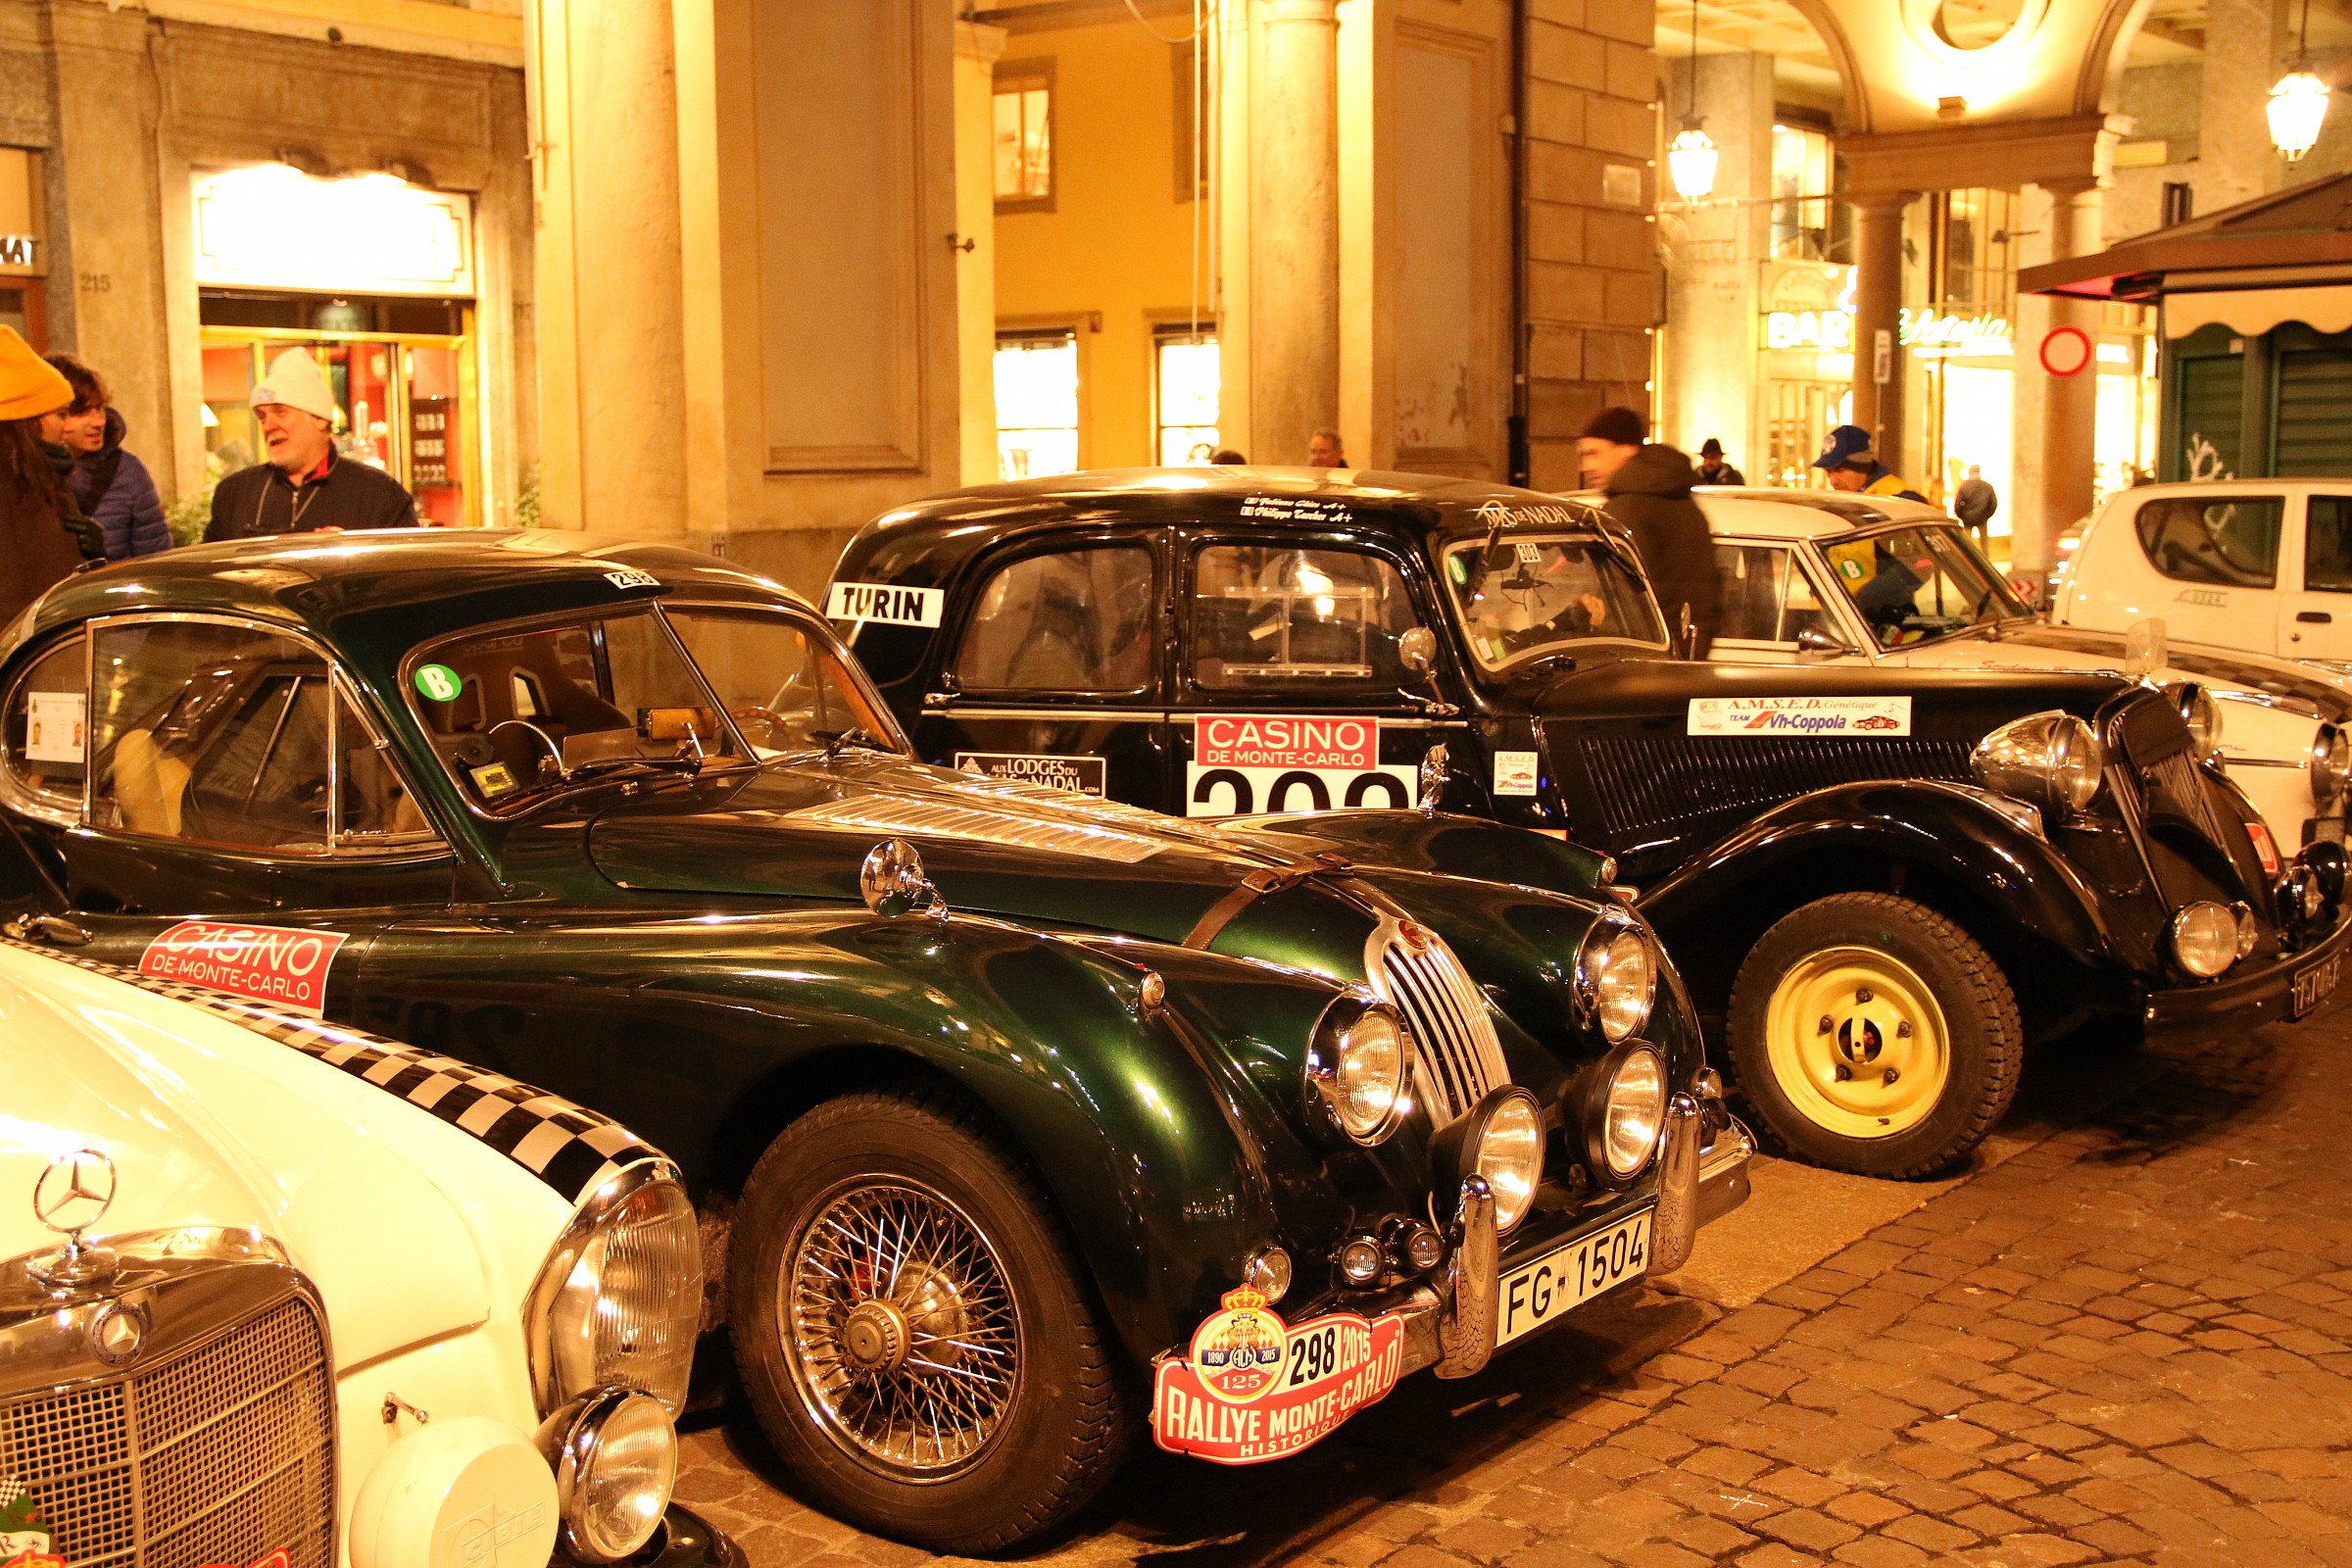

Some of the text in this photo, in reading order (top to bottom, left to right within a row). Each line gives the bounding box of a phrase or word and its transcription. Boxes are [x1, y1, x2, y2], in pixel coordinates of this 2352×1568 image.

[1767, 311, 1850, 348] BAR
[1522, 506, 1575, 524] NADAL
[1519, 543, 1540, 562] 303
[611, 572, 656, 586] 298
[1448, 555, 1465, 583] B
[1842, 560, 1861, 578] B
[843, 587, 924, 621] TURIN
[419, 666, 454, 701] B
[1207, 719, 1365, 751] CASINO
[1770, 714, 1846, 733] Vh-Coppola
[1007, 759, 1065, 776] LODGES
[1065, 767, 1078, 776] DU
[1206, 750, 1365, 767] DE MONTE-CARLO
[166, 925, 322, 977] CASINO
[151, 954, 312, 1002] DE MONTE-CARLO
[1207, 1351, 1225, 1365] 1890
[1261, 1348, 1276, 1362] 2015
[1289, 1326, 1337, 1387] 298
[1342, 1325, 1372, 1372] 2015
[1167, 1385, 1261, 1445] RALLYE
[1268, 1339, 1400, 1440] MONTE-CARLO
[1221, 1373, 1262, 1390] 125
[1240, 1410, 1349, 1457] HISTORIQUE
